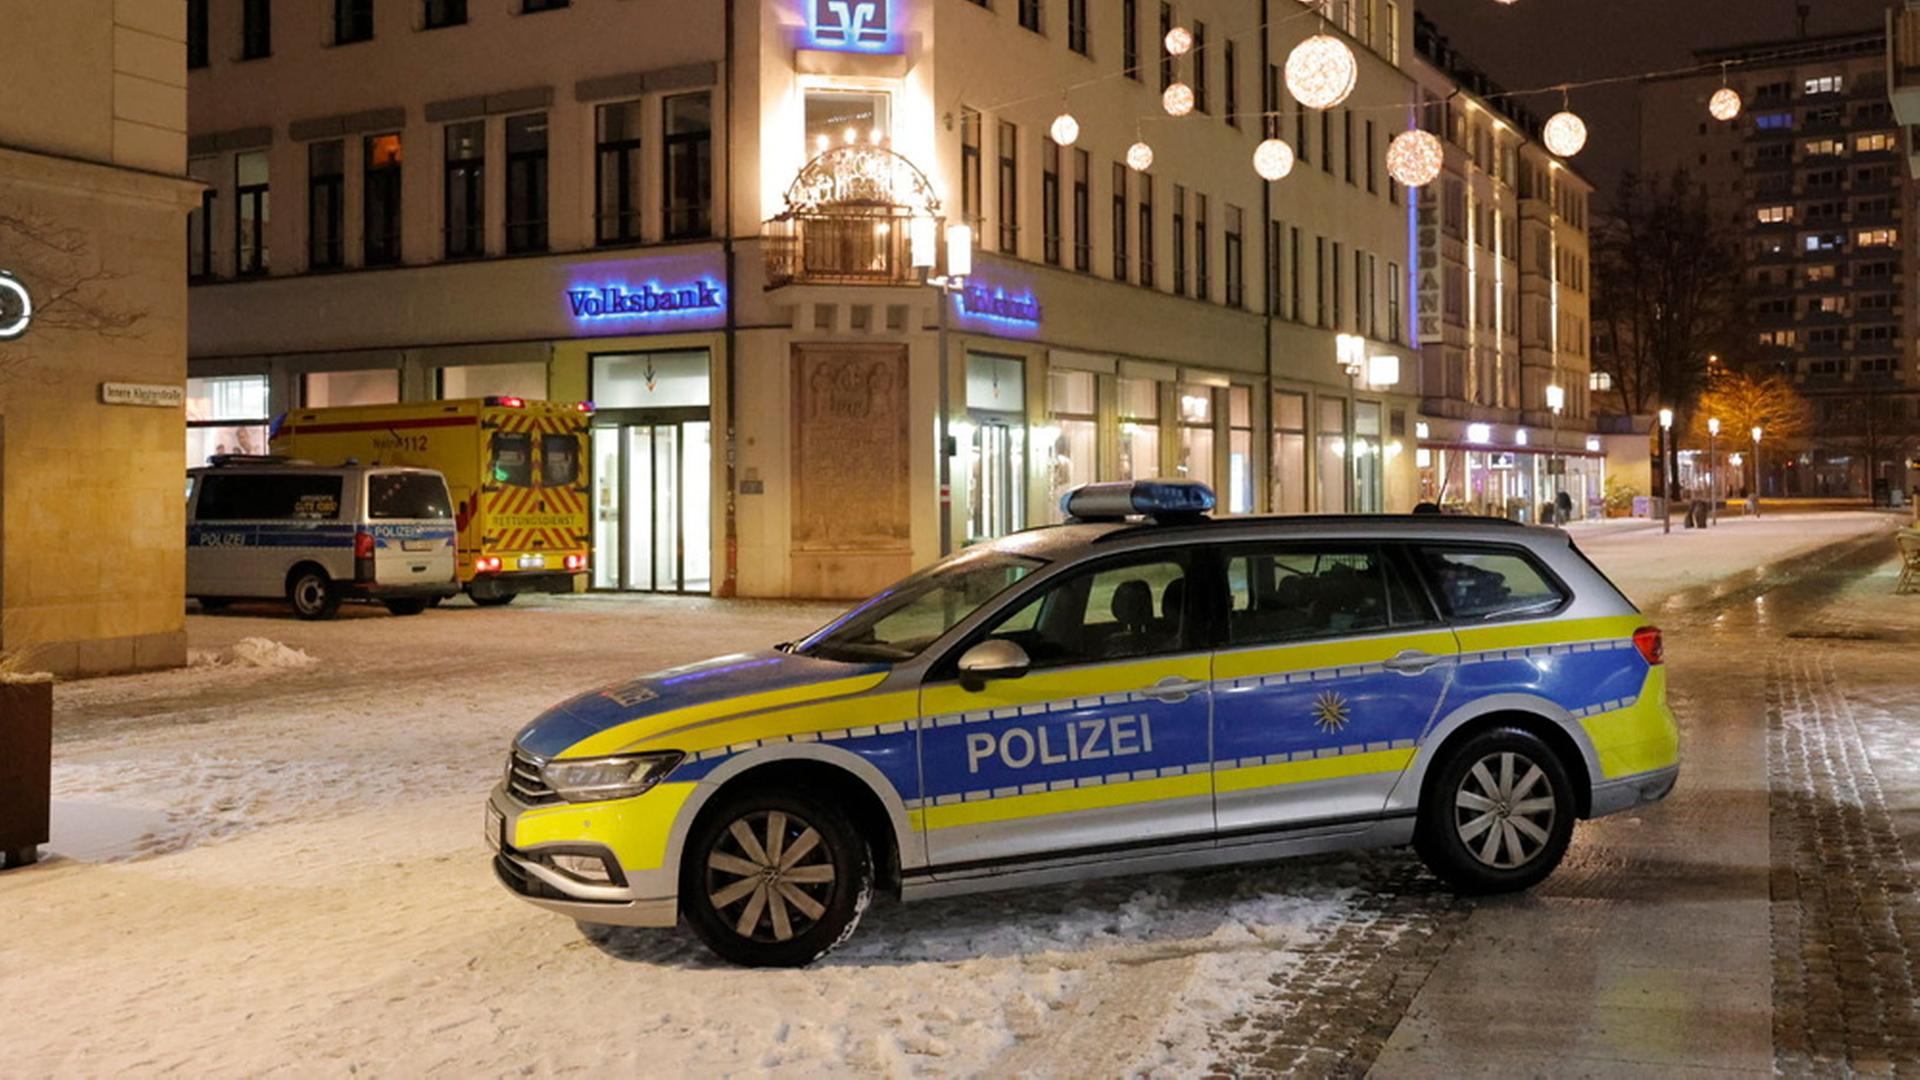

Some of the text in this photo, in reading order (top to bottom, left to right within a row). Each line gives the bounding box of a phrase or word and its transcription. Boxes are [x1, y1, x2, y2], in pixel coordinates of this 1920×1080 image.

[567, 280, 721, 317] Volksbank
[404, 434, 429, 452] 112
[200, 532, 246, 546] POLIZEI
[966, 713, 1153, 774] POLIZEI
